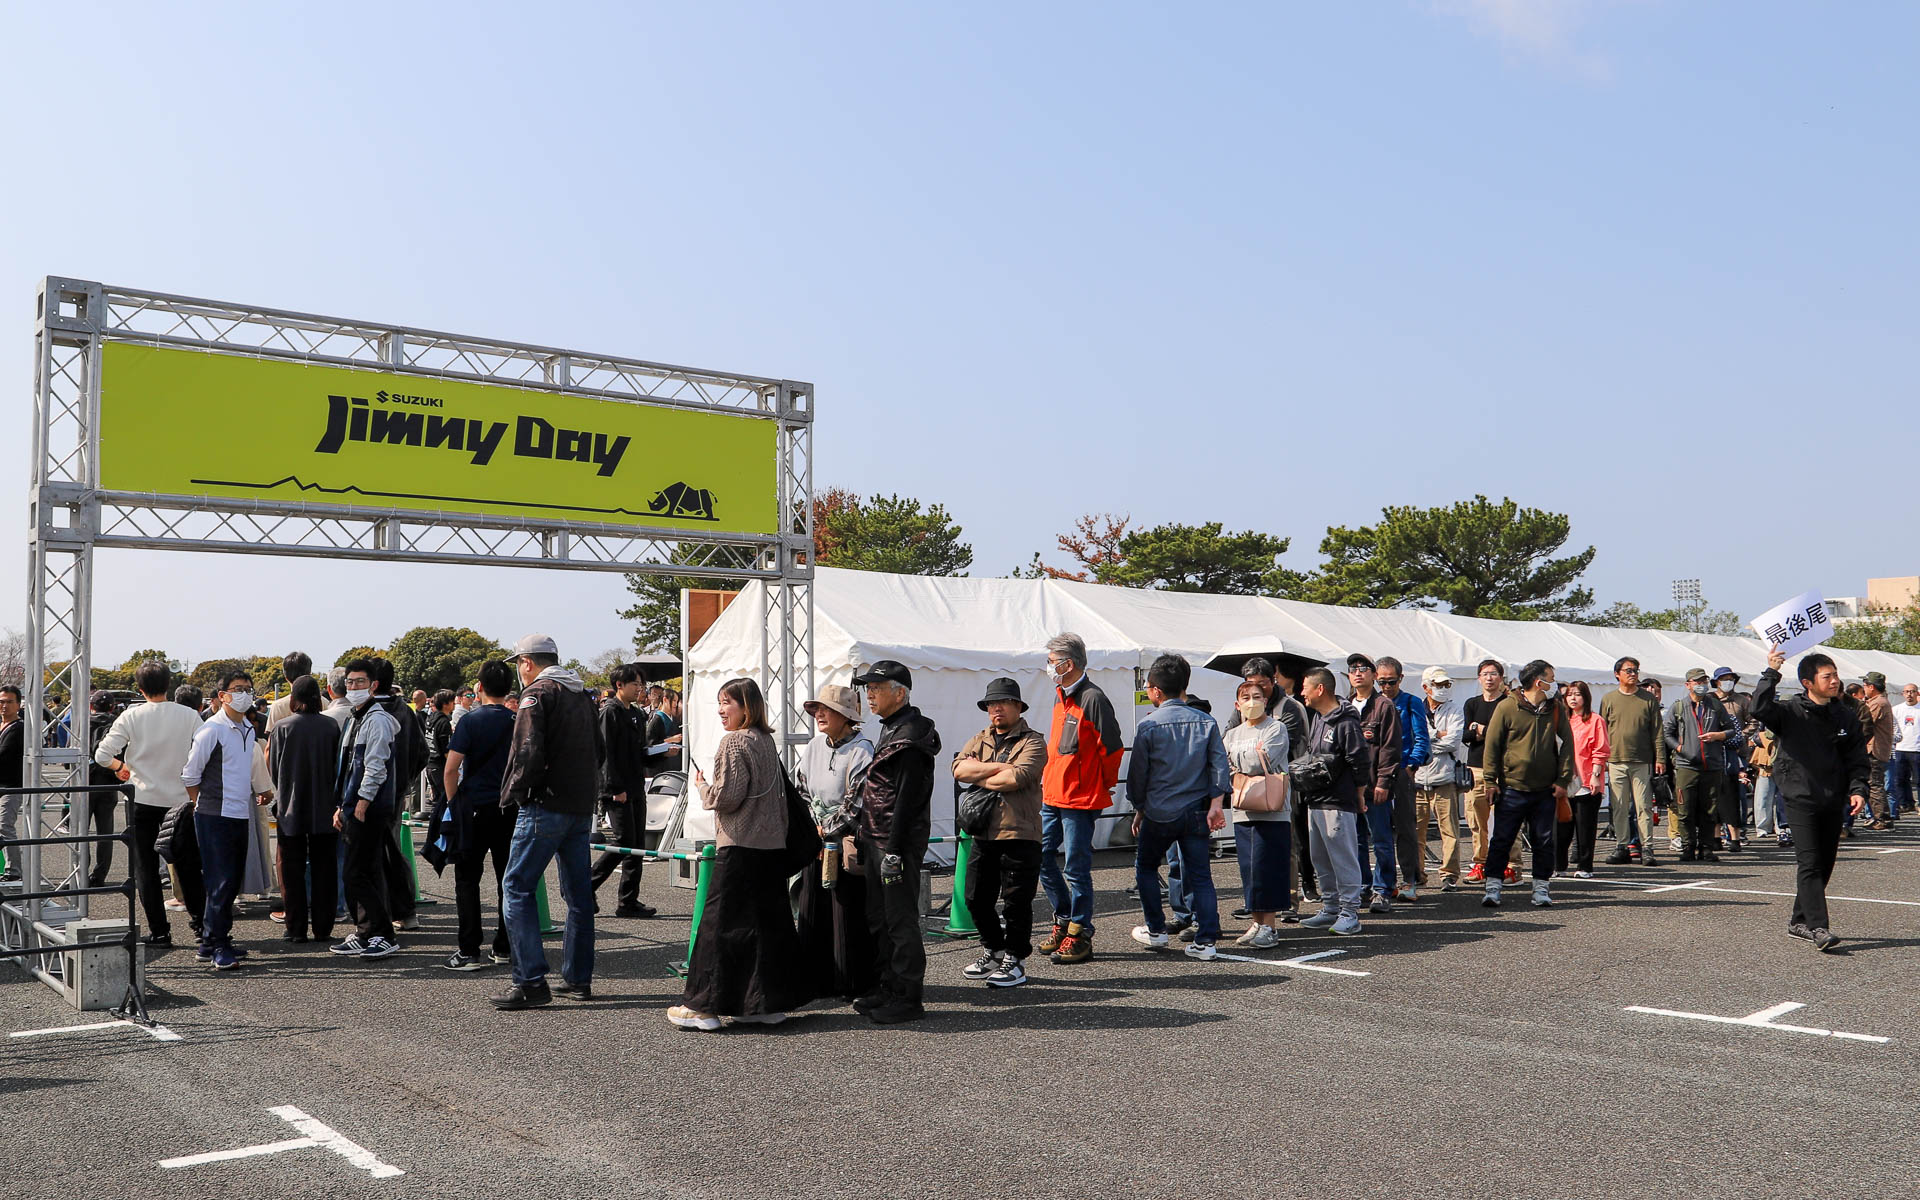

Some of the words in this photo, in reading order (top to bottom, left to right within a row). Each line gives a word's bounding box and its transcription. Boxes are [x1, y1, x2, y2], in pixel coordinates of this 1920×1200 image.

[391, 393, 444, 408] SUZUKI
[314, 394, 510, 466] Jimny
[513, 415, 632, 478] Day
[1764, 602, 1827, 645] 最後尾
